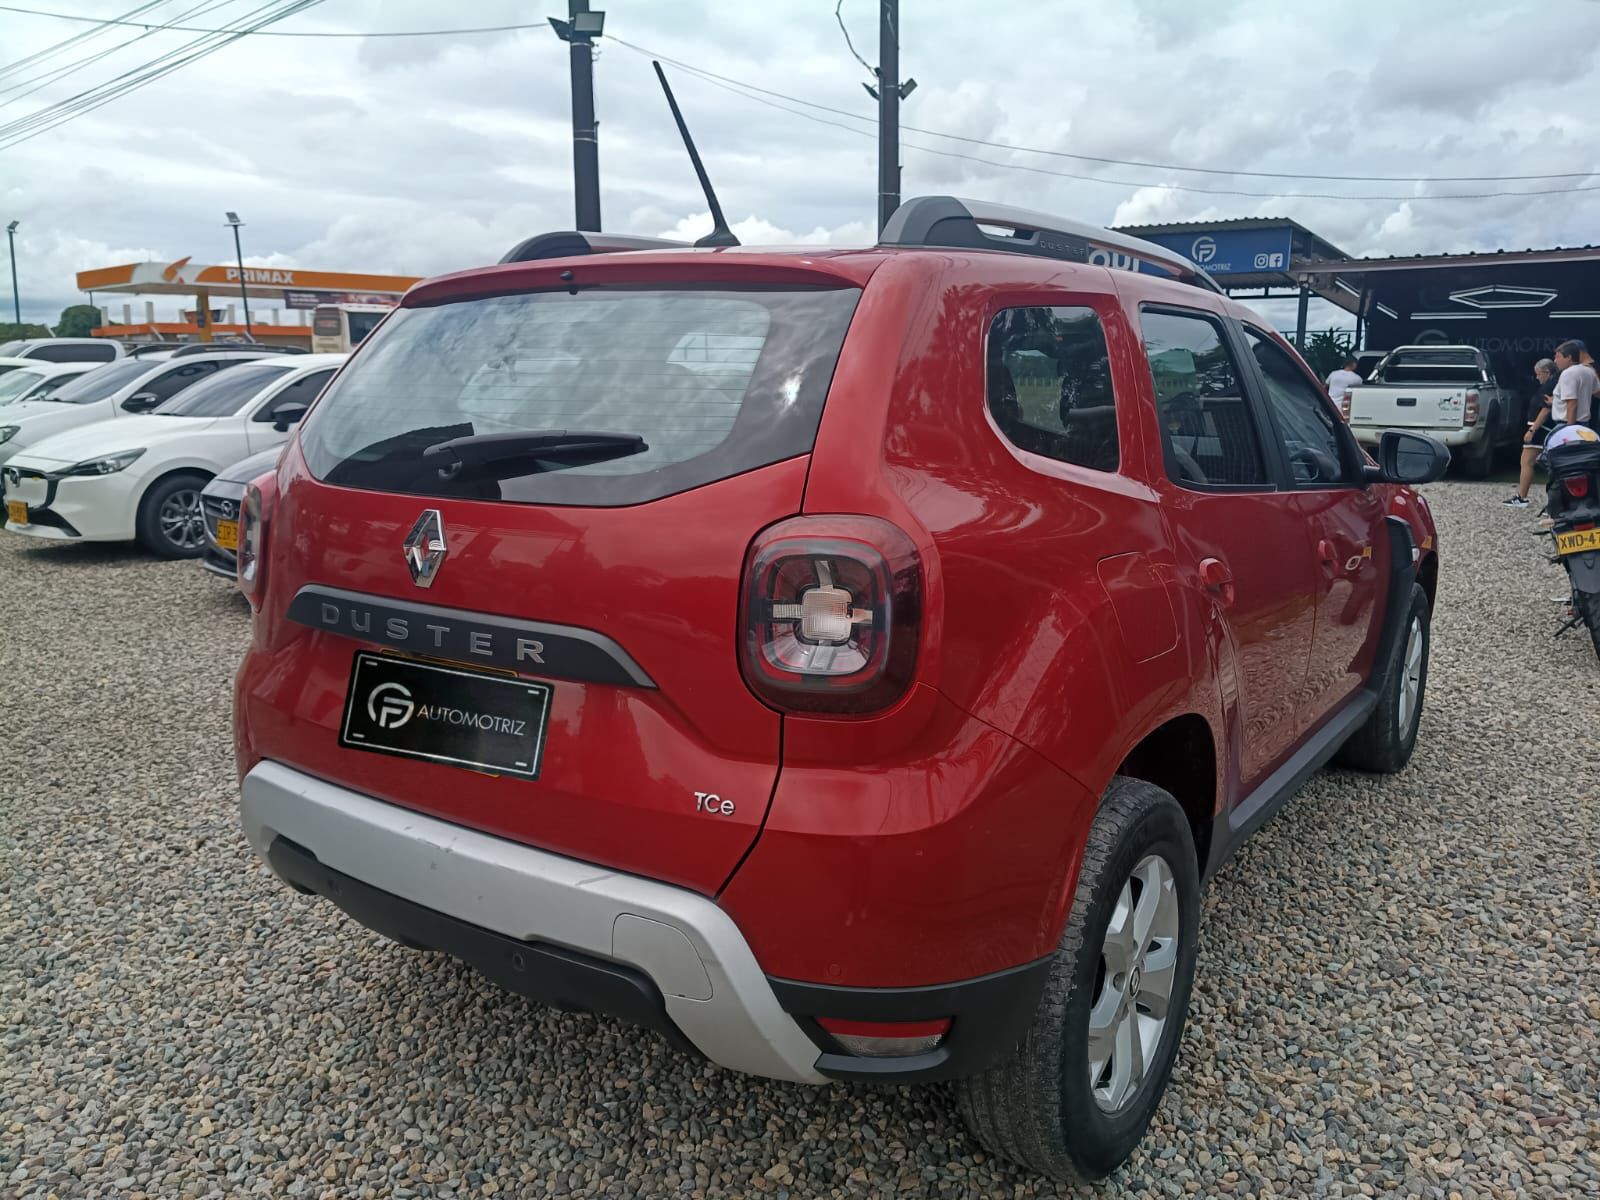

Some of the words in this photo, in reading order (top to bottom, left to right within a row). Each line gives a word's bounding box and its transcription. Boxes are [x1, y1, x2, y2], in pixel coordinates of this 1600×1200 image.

[226, 268, 294, 284] PRIMAX
[321, 602, 545, 664] DUSTER
[417, 703, 526, 737] AUTOMOTRIZ
[694, 791, 735, 816] TCe
